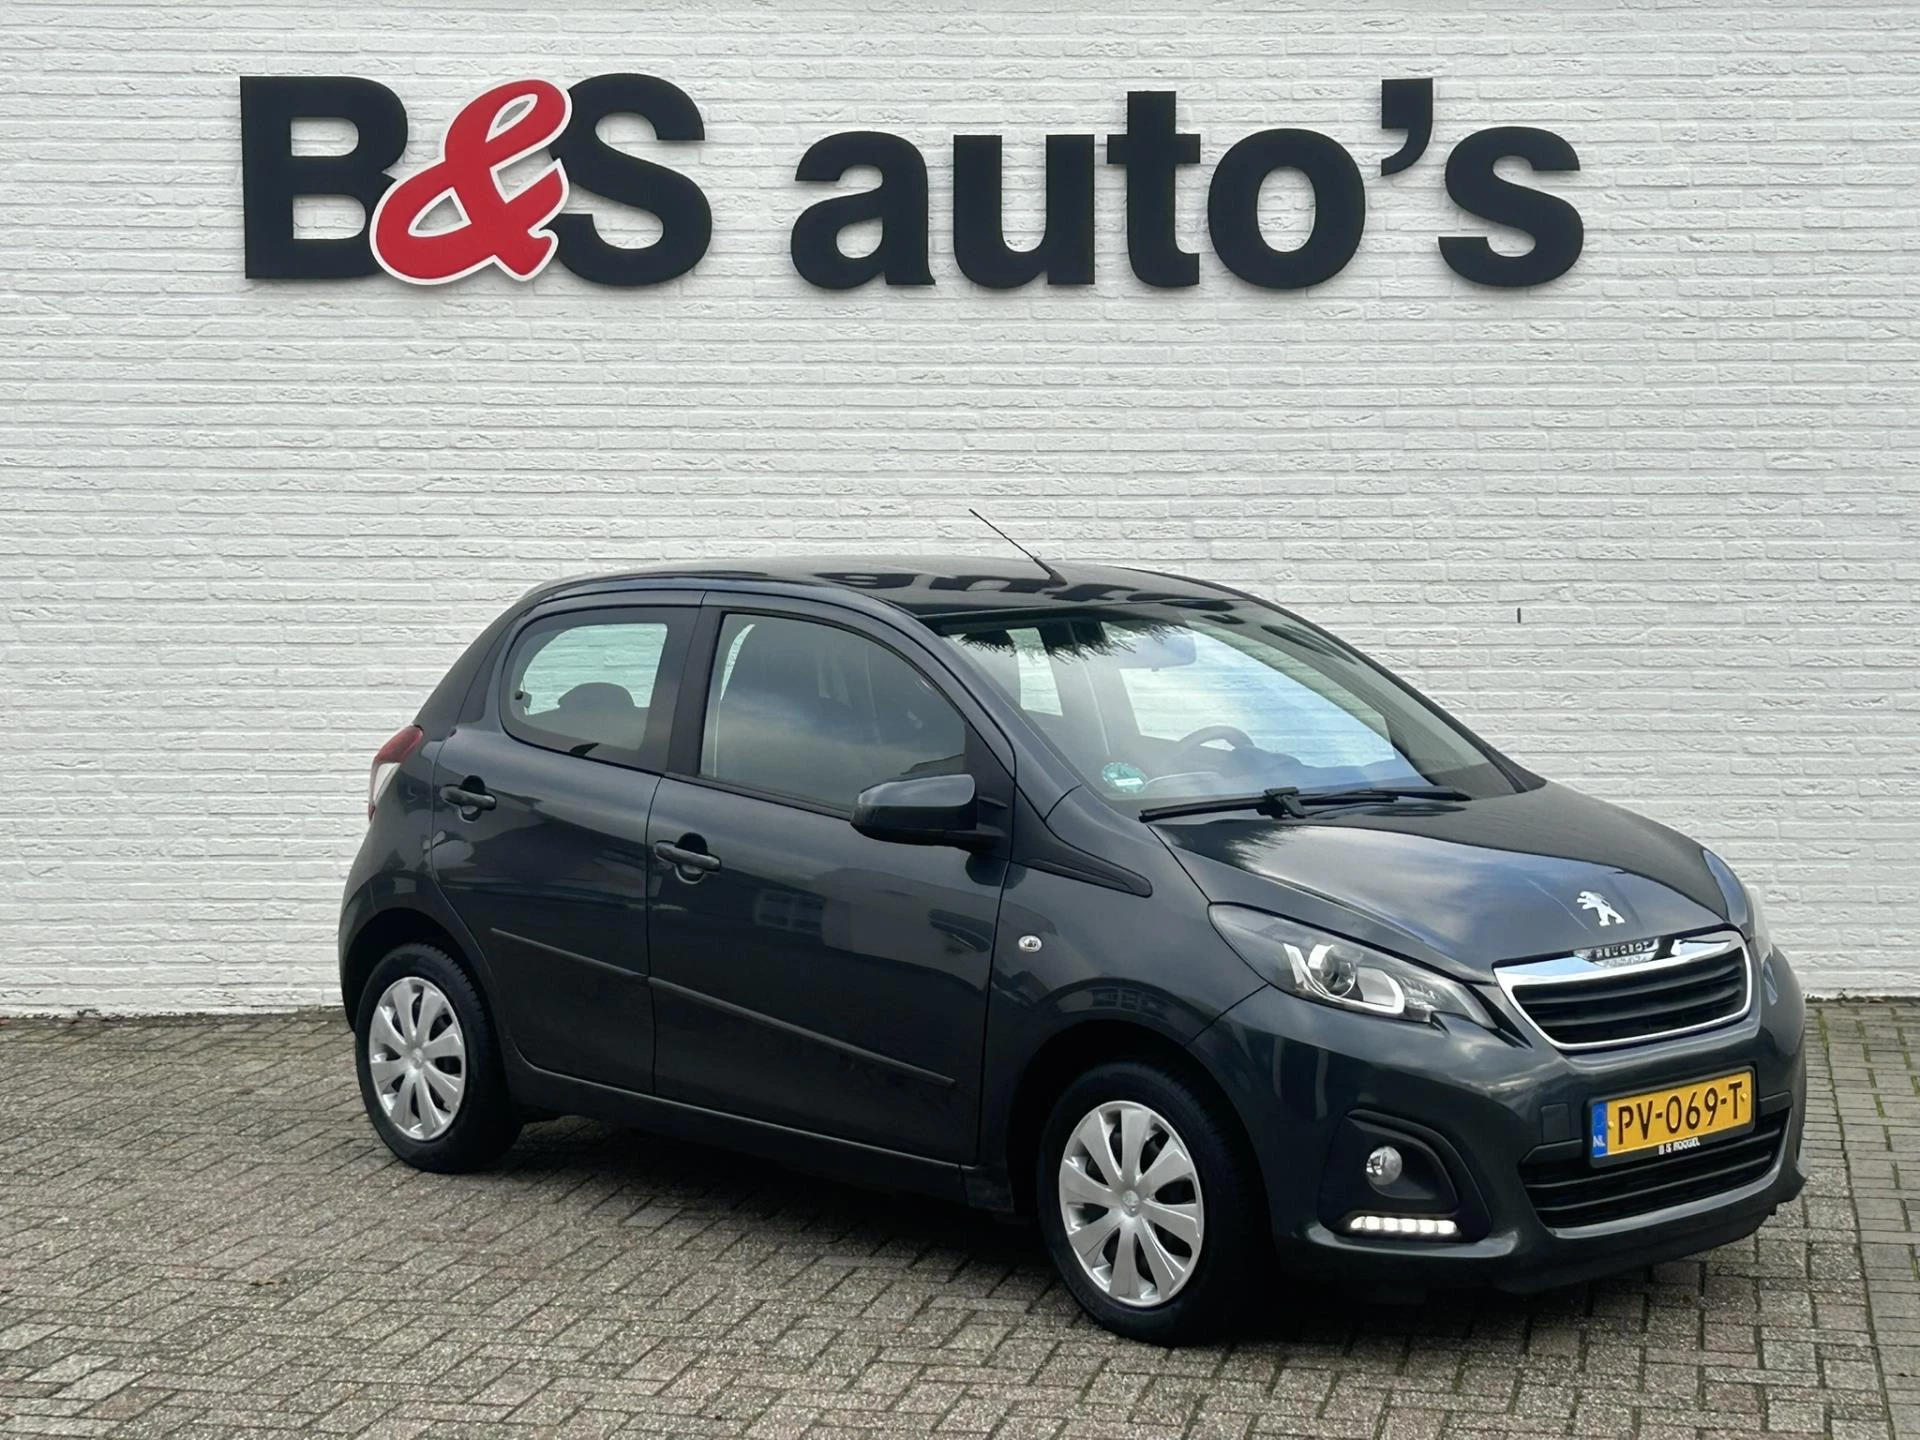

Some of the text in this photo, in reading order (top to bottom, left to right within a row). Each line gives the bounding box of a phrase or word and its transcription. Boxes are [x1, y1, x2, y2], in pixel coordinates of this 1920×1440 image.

[240, 73, 712, 287] B&S
[1593, 1135, 1606, 1147] NL
[1618, 1081, 1743, 1145] PV-069-T
